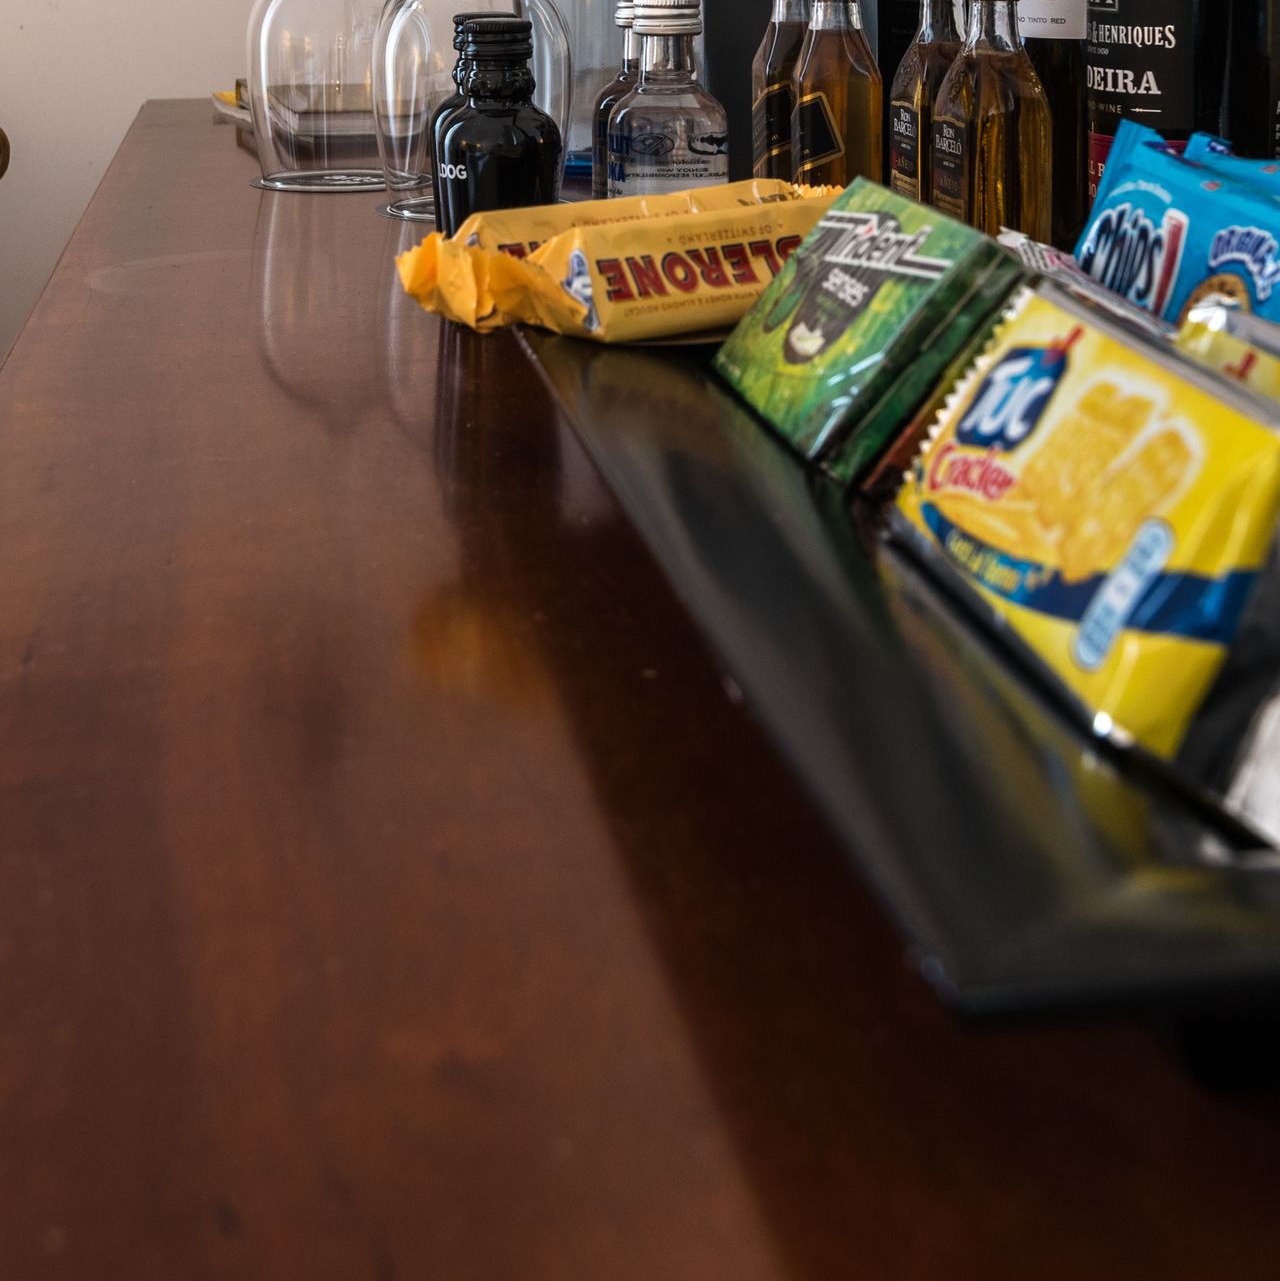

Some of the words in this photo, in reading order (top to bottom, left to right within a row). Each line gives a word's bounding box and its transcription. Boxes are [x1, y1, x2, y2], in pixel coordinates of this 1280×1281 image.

[1028, 17, 1048, 25] TINTO
[1050, 17, 1067, 25] RED
[1098, 24, 1177, 49] HENRIQUES
[900, 108, 911, 121] RON
[893, 118, 916, 138] BARCELÓ
[943, 124, 955, 139] RON
[935, 134, 962, 155] BARCELÓ
[677, 226, 756, 245] SWITZERLAND
[818, 209, 954, 280] Trident
[958, 356, 1055, 440] TUC
[928, 442, 1017, 502] Cracker
